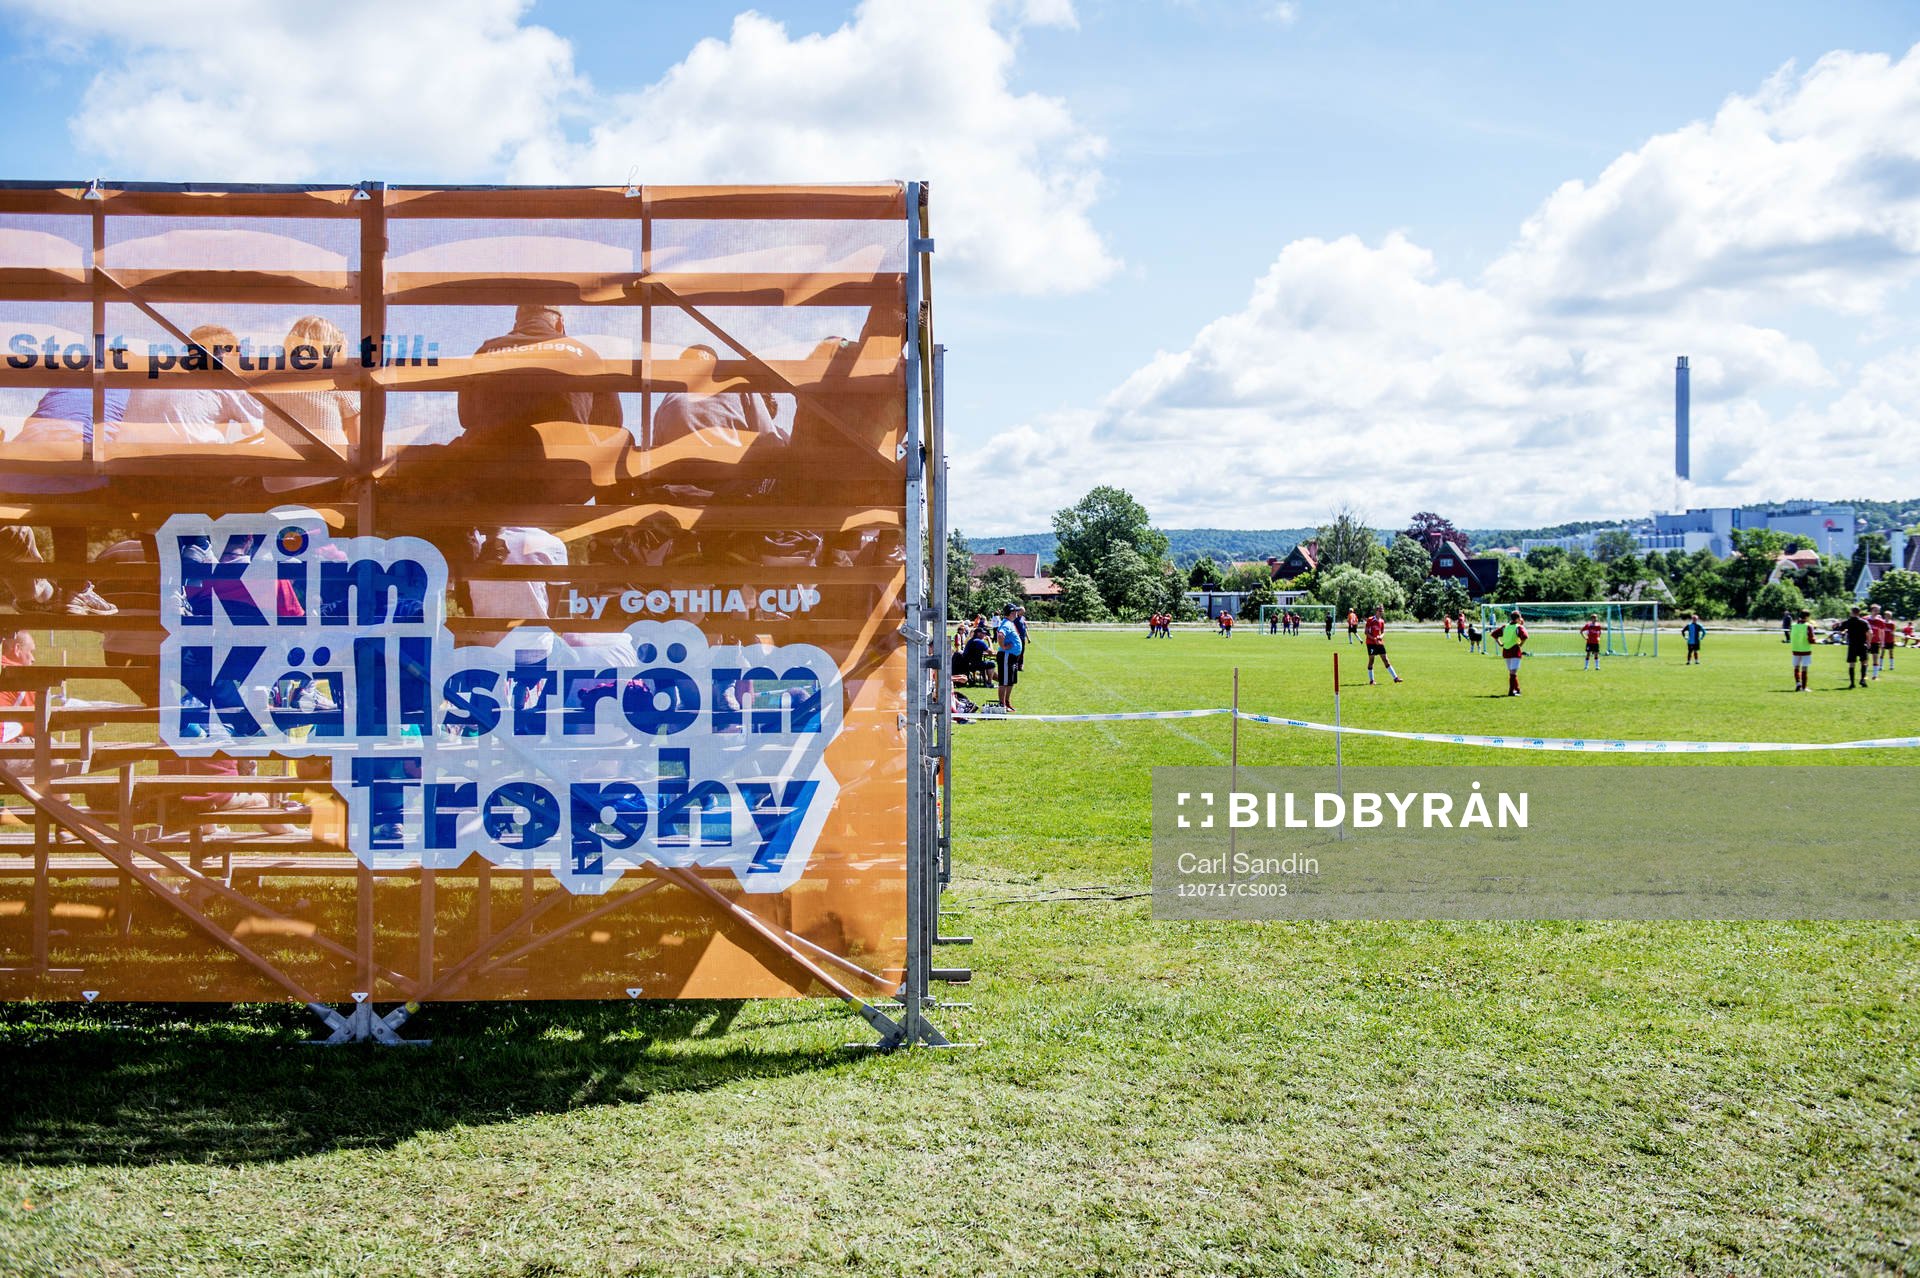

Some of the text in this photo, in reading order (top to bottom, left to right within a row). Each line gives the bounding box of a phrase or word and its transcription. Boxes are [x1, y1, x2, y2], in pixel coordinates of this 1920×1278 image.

[7, 333, 439, 378] Stolt partner till:
[177, 526, 429, 626] Kim
[569, 589, 820, 619] by GOTHIA CUP
[179, 637, 821, 738] Källström
[352, 748, 819, 875] Trophy
